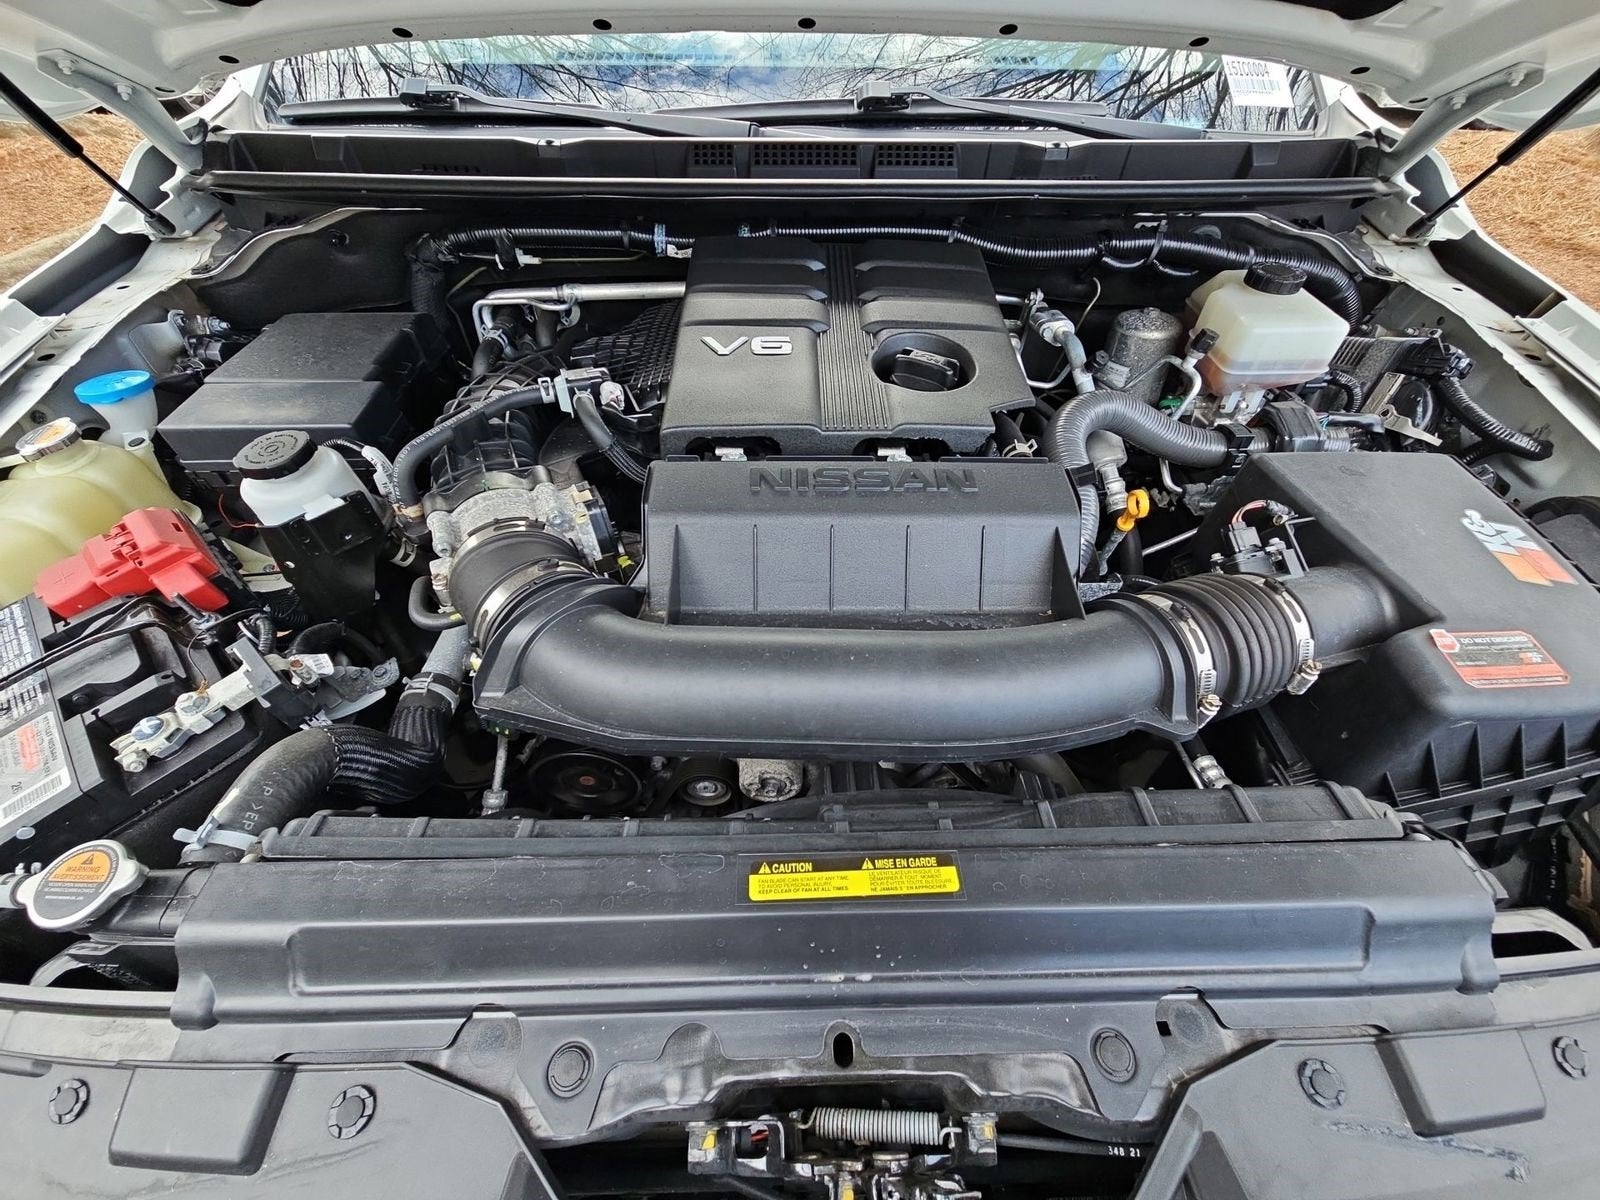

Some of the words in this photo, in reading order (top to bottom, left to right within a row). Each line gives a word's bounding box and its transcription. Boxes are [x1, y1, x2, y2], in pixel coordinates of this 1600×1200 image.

[700, 335, 794, 356] V6
[750, 467, 979, 493] NISSAN
[772, 863, 812, 873] CAUTION
[875, 859, 895, 868] MISE
[896, 858, 907, 868] EN
[909, 857, 937, 867] GARDE
[1129, 1147, 1141, 1157] 21
